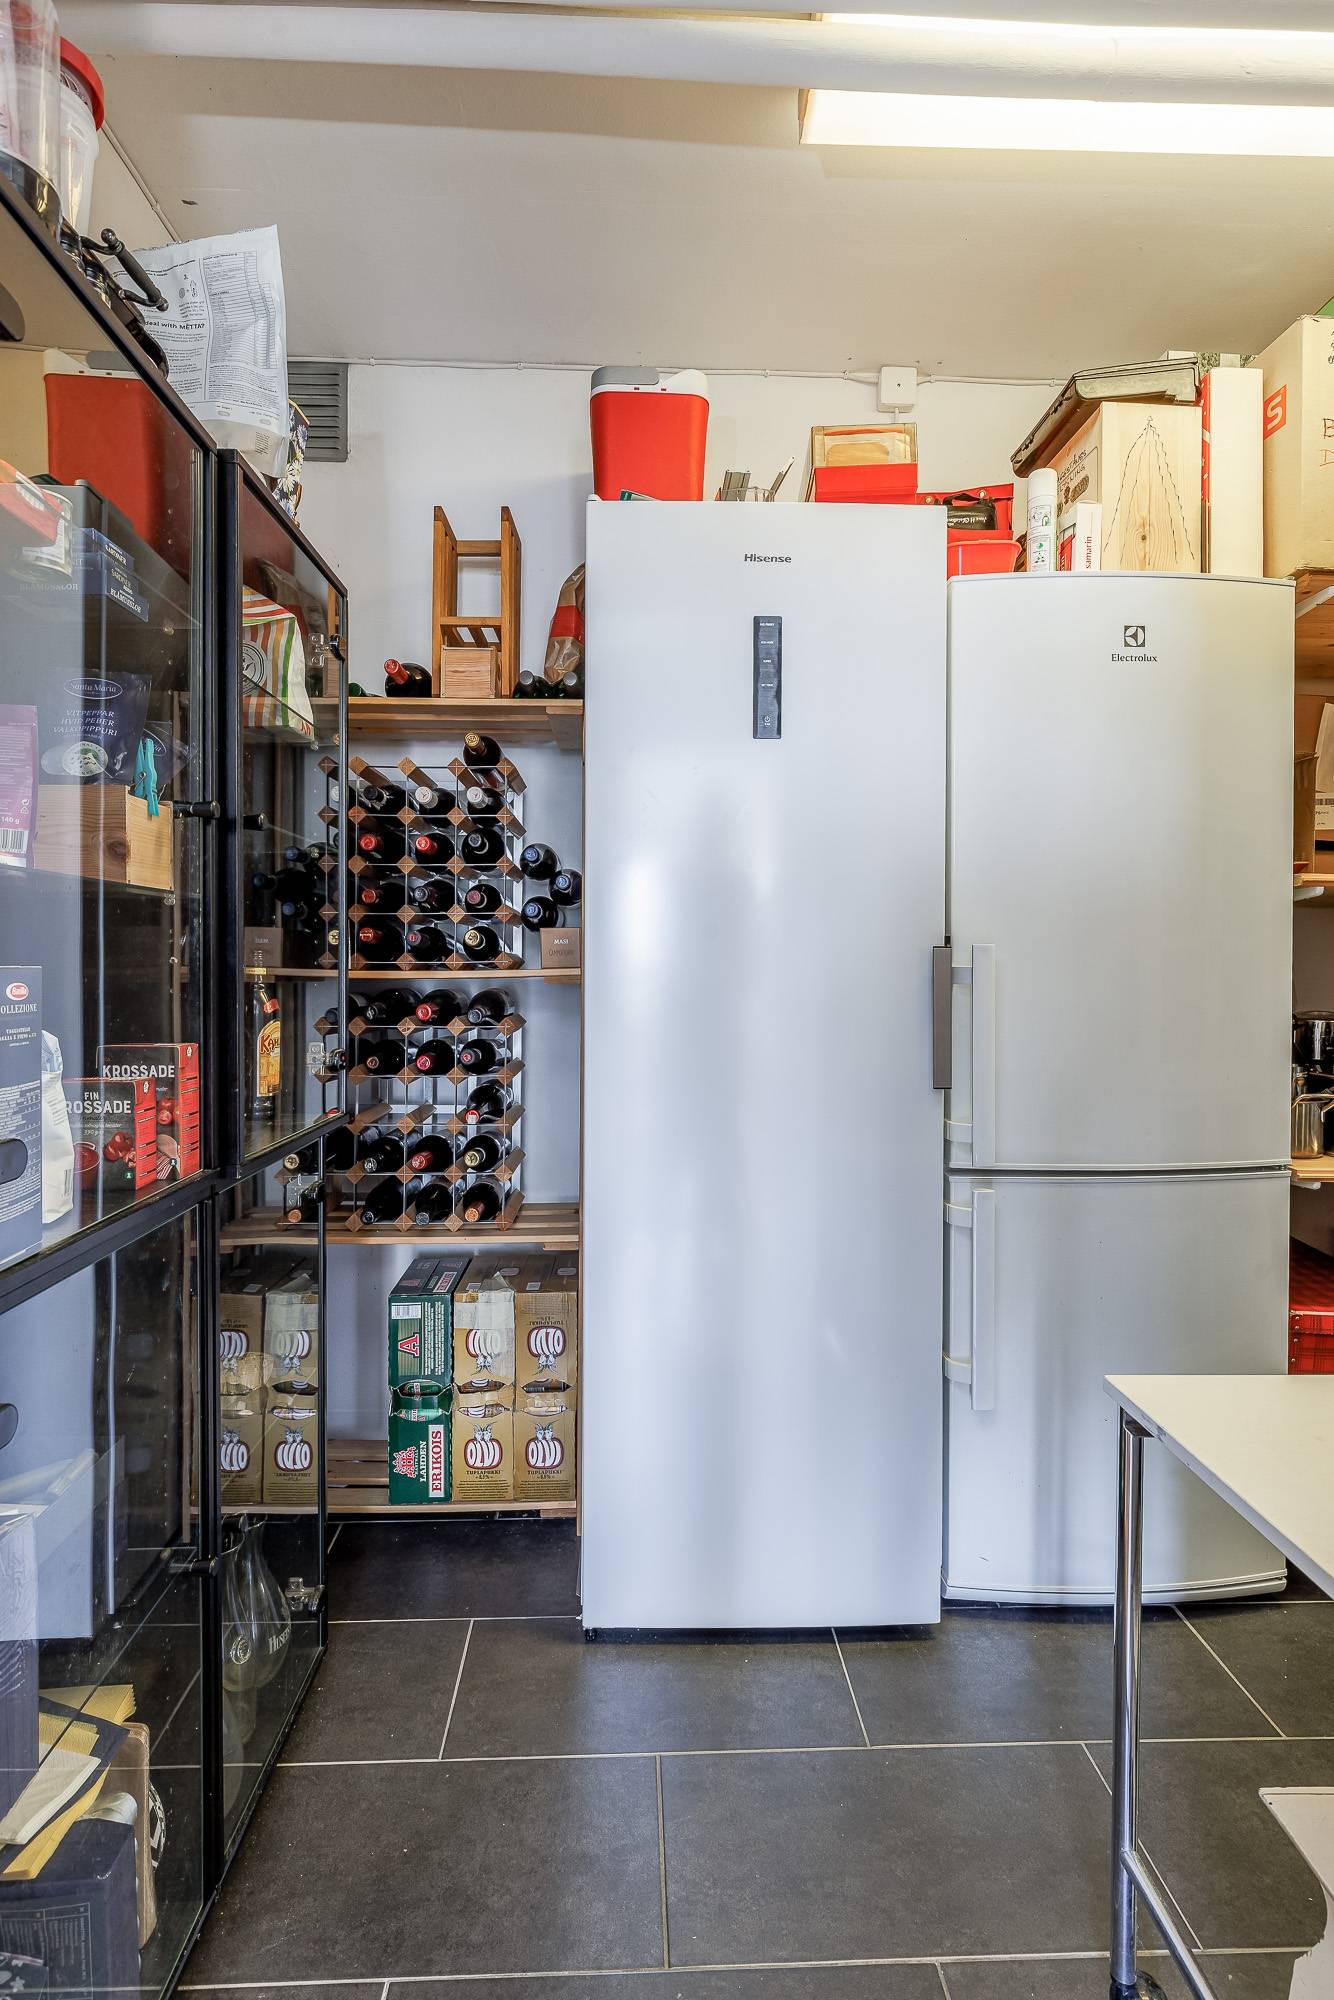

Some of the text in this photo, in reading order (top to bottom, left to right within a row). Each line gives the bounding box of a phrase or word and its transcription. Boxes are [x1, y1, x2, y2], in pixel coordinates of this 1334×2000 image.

[1266, 395, 1283, 431] S
[744, 553, 792, 563] Hisense
[1085, 536, 1093, 569] samarin
[1111, 653, 1158, 662] Electrolux
[70, 682, 117, 693] Santa Maria
[66, 709, 115, 718] VITPEPPAR
[86, 717, 116, 727] PEBER
[52, 726, 118, 737] VALKOPIPPURI
[0, 1003, 38, 1014] OLLEZIONE
[102, 1064, 175, 1078] KROSSADE
[84, 1091, 99, 1100] FIN
[66, 1100, 132, 1114] ROSSADE
[398, 1332, 421, 1357] A
[530, 1328, 563, 1355] OLVI
[431, 1430, 443, 1492] ERIKOIS
[466, 1440, 501, 1468] OLVI
[527, 1440, 562, 1468] OLVI
